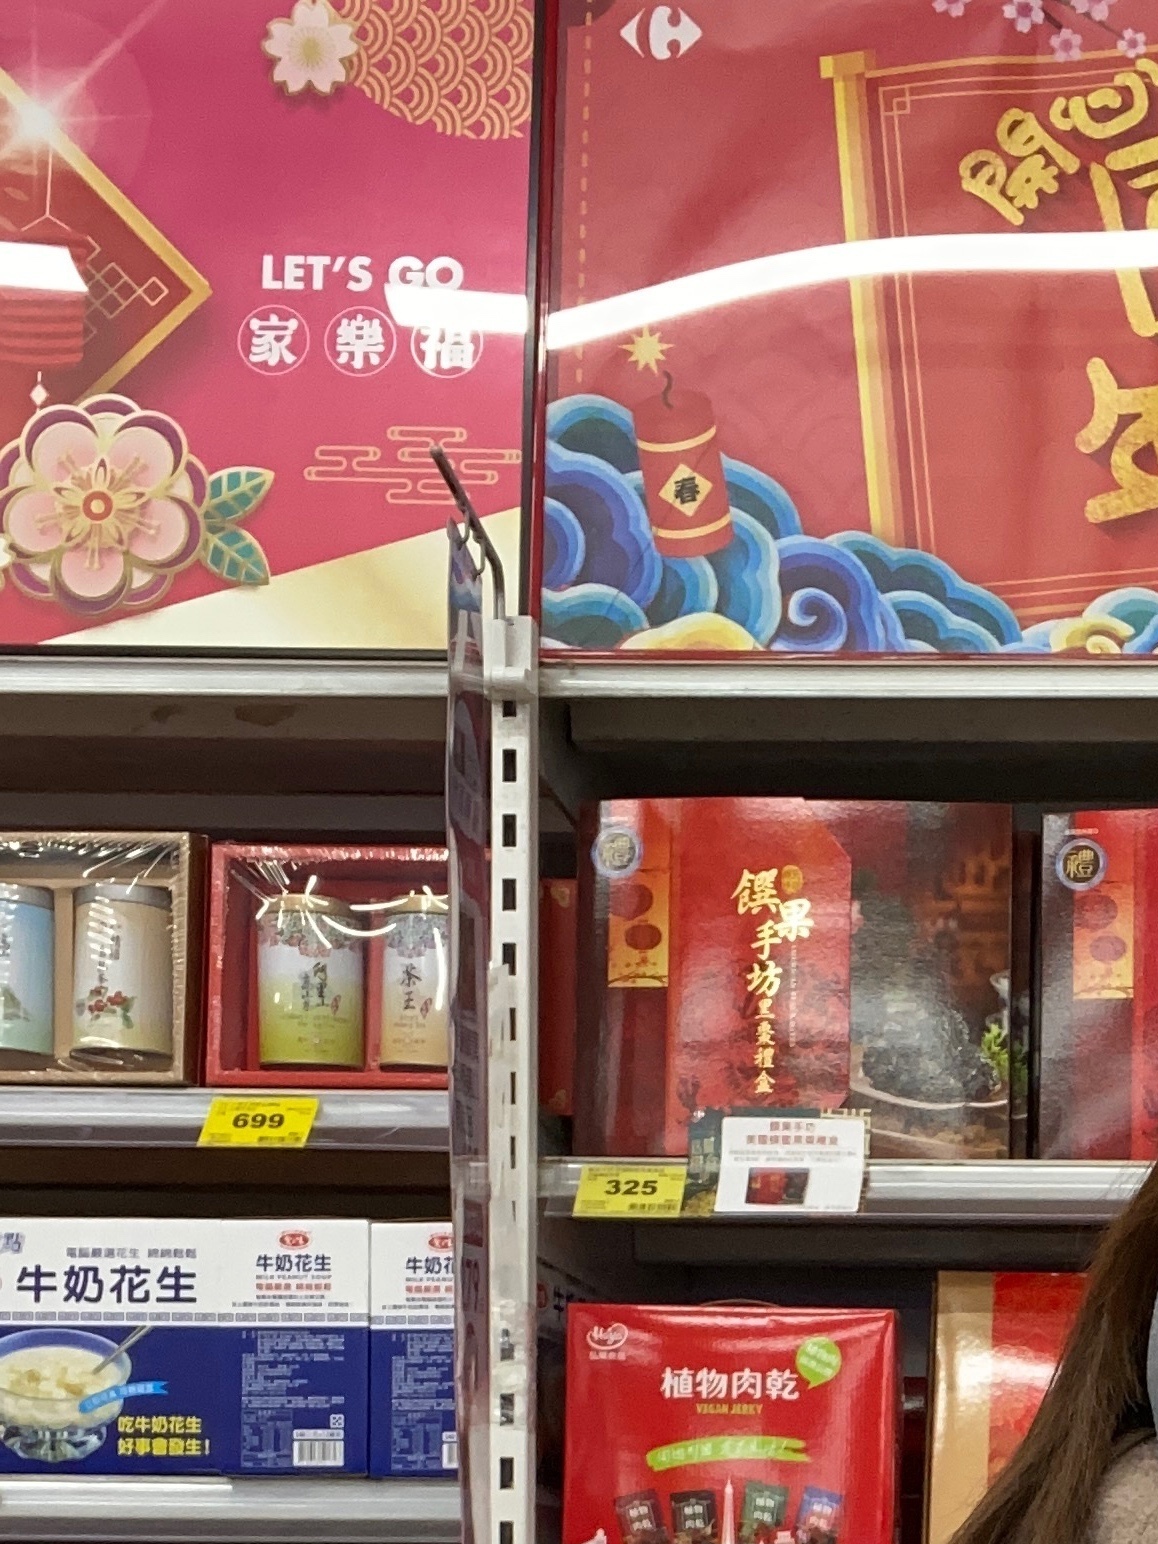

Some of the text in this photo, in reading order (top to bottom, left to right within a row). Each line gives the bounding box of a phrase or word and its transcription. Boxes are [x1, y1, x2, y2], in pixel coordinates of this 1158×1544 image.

[388, 255, 465, 291] GO
[247, 312, 476, 372] 家樂福
[1065, 848, 1096, 879] 禮
[232, 1111, 286, 1130] 699
[604, 1178, 659, 1197] 325
[255, 1253, 332, 1273] 牛奶花生
[16, 1264, 197, 1303] 牛奶花生
[660, 1366, 800, 1401] 植物肉乾
[696, 1403, 763, 1415] VEGAN JERKY
[117, 1415, 202, 1433] 吃牛奶花生
